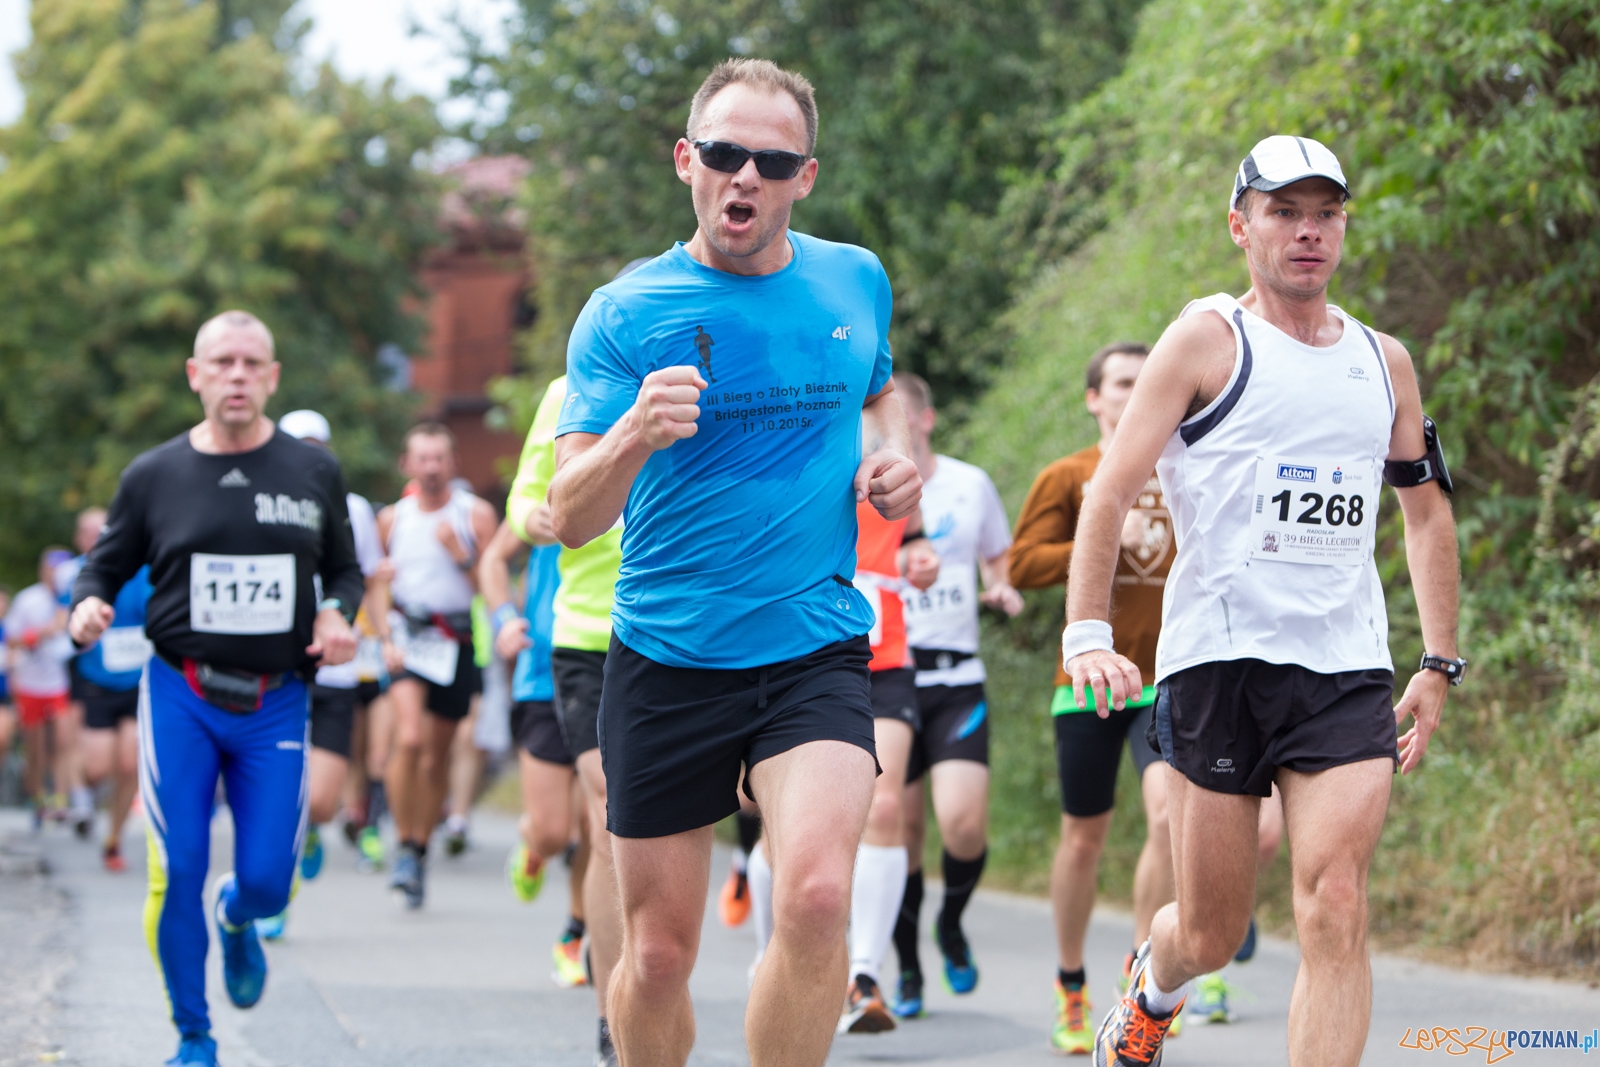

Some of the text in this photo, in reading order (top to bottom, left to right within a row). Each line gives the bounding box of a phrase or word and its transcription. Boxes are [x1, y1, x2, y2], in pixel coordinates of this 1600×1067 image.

[831, 325, 851, 341] 4F
[723, 391, 752, 405] Bieg
[756, 390, 765, 400] o
[768, 385, 801, 399] Złoty
[805, 381, 848, 395] Bieżnik
[714, 397, 841, 422] Bridgestone Poznań
[742, 417, 815, 434] 11.10.2015r.
[1271, 489, 1364, 527] 1268
[1284, 533, 1362, 547] 39 BIEG LECHITÓW
[204, 580, 282, 604] 1174
